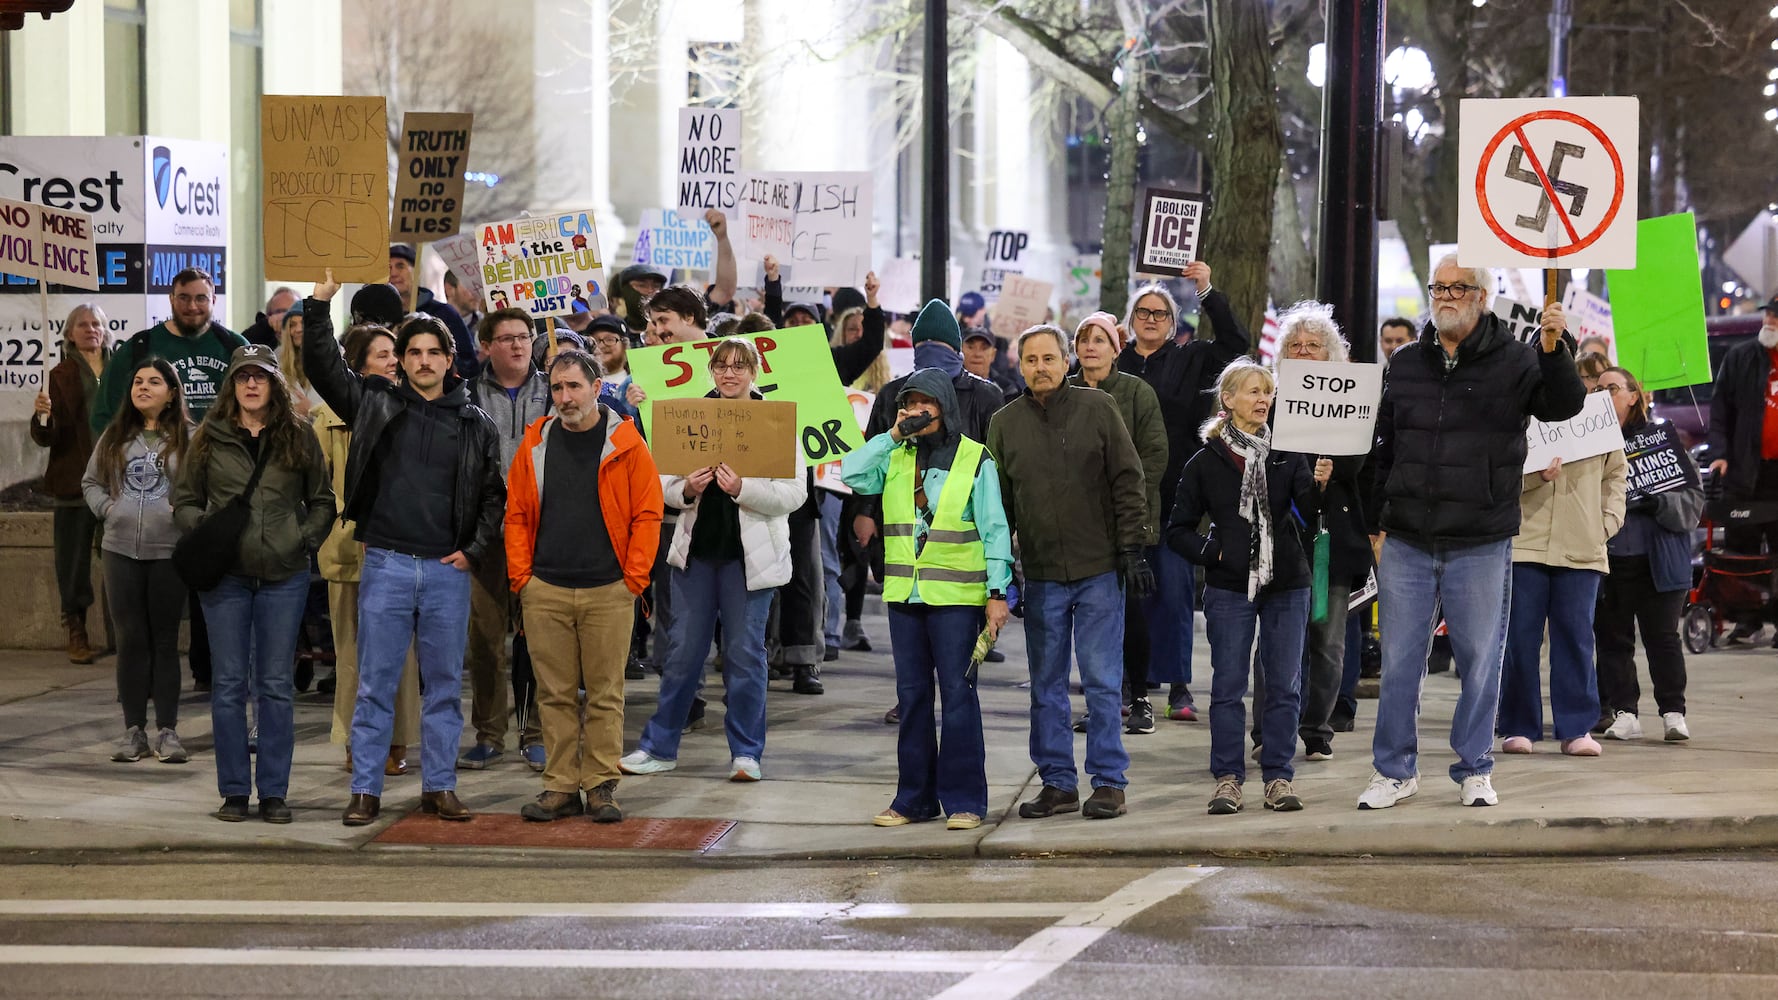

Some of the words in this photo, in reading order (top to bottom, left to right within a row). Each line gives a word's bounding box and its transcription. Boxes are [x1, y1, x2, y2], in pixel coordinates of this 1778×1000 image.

[270, 103, 383, 143] UNMASK
[688, 113, 722, 141] NO
[408, 130, 466, 151] TRUTH
[304, 146, 340, 168] AND
[409, 156, 459, 178] ONLY
[681, 145, 736, 174] MORE
[0, 163, 123, 213] rest
[174, 166, 220, 217] Crest
[270, 172, 376, 197] PROSECUTE!
[419, 182, 445, 196] no
[680, 181, 736, 208] NAZIS
[750, 178, 769, 205] ICE
[771, 182, 790, 209] ARE
[401, 198, 456, 213] more
[1155, 201, 1197, 217] ABOLISH
[41, 211, 87, 240] MORE
[272, 200, 369, 259] ICE
[482, 213, 593, 248] AMERICA
[1151, 214, 1195, 252] ICE
[531, 241, 564, 256] the
[482, 249, 603, 285] BEAUTIFUL
[513, 276, 572, 302] PROUD
[530, 295, 566, 313] JUST
[109, 319, 128, 332] or
[187, 356, 195, 368] A
[195, 355, 229, 372] BEAUT
[662, 336, 777, 388] STP
[183, 381, 217, 395] CLARK
[1302, 374, 1356, 394] STOP
[663, 405, 705, 421] Human
[717, 407, 752, 425] Rights
[1285, 400, 1370, 419] TRUMP!!!
[1569, 397, 1618, 439] Good!
[1637, 430, 1668, 449] People
[1636, 449, 1678, 475] KINGS
[1635, 463, 1684, 490] AMERICA
